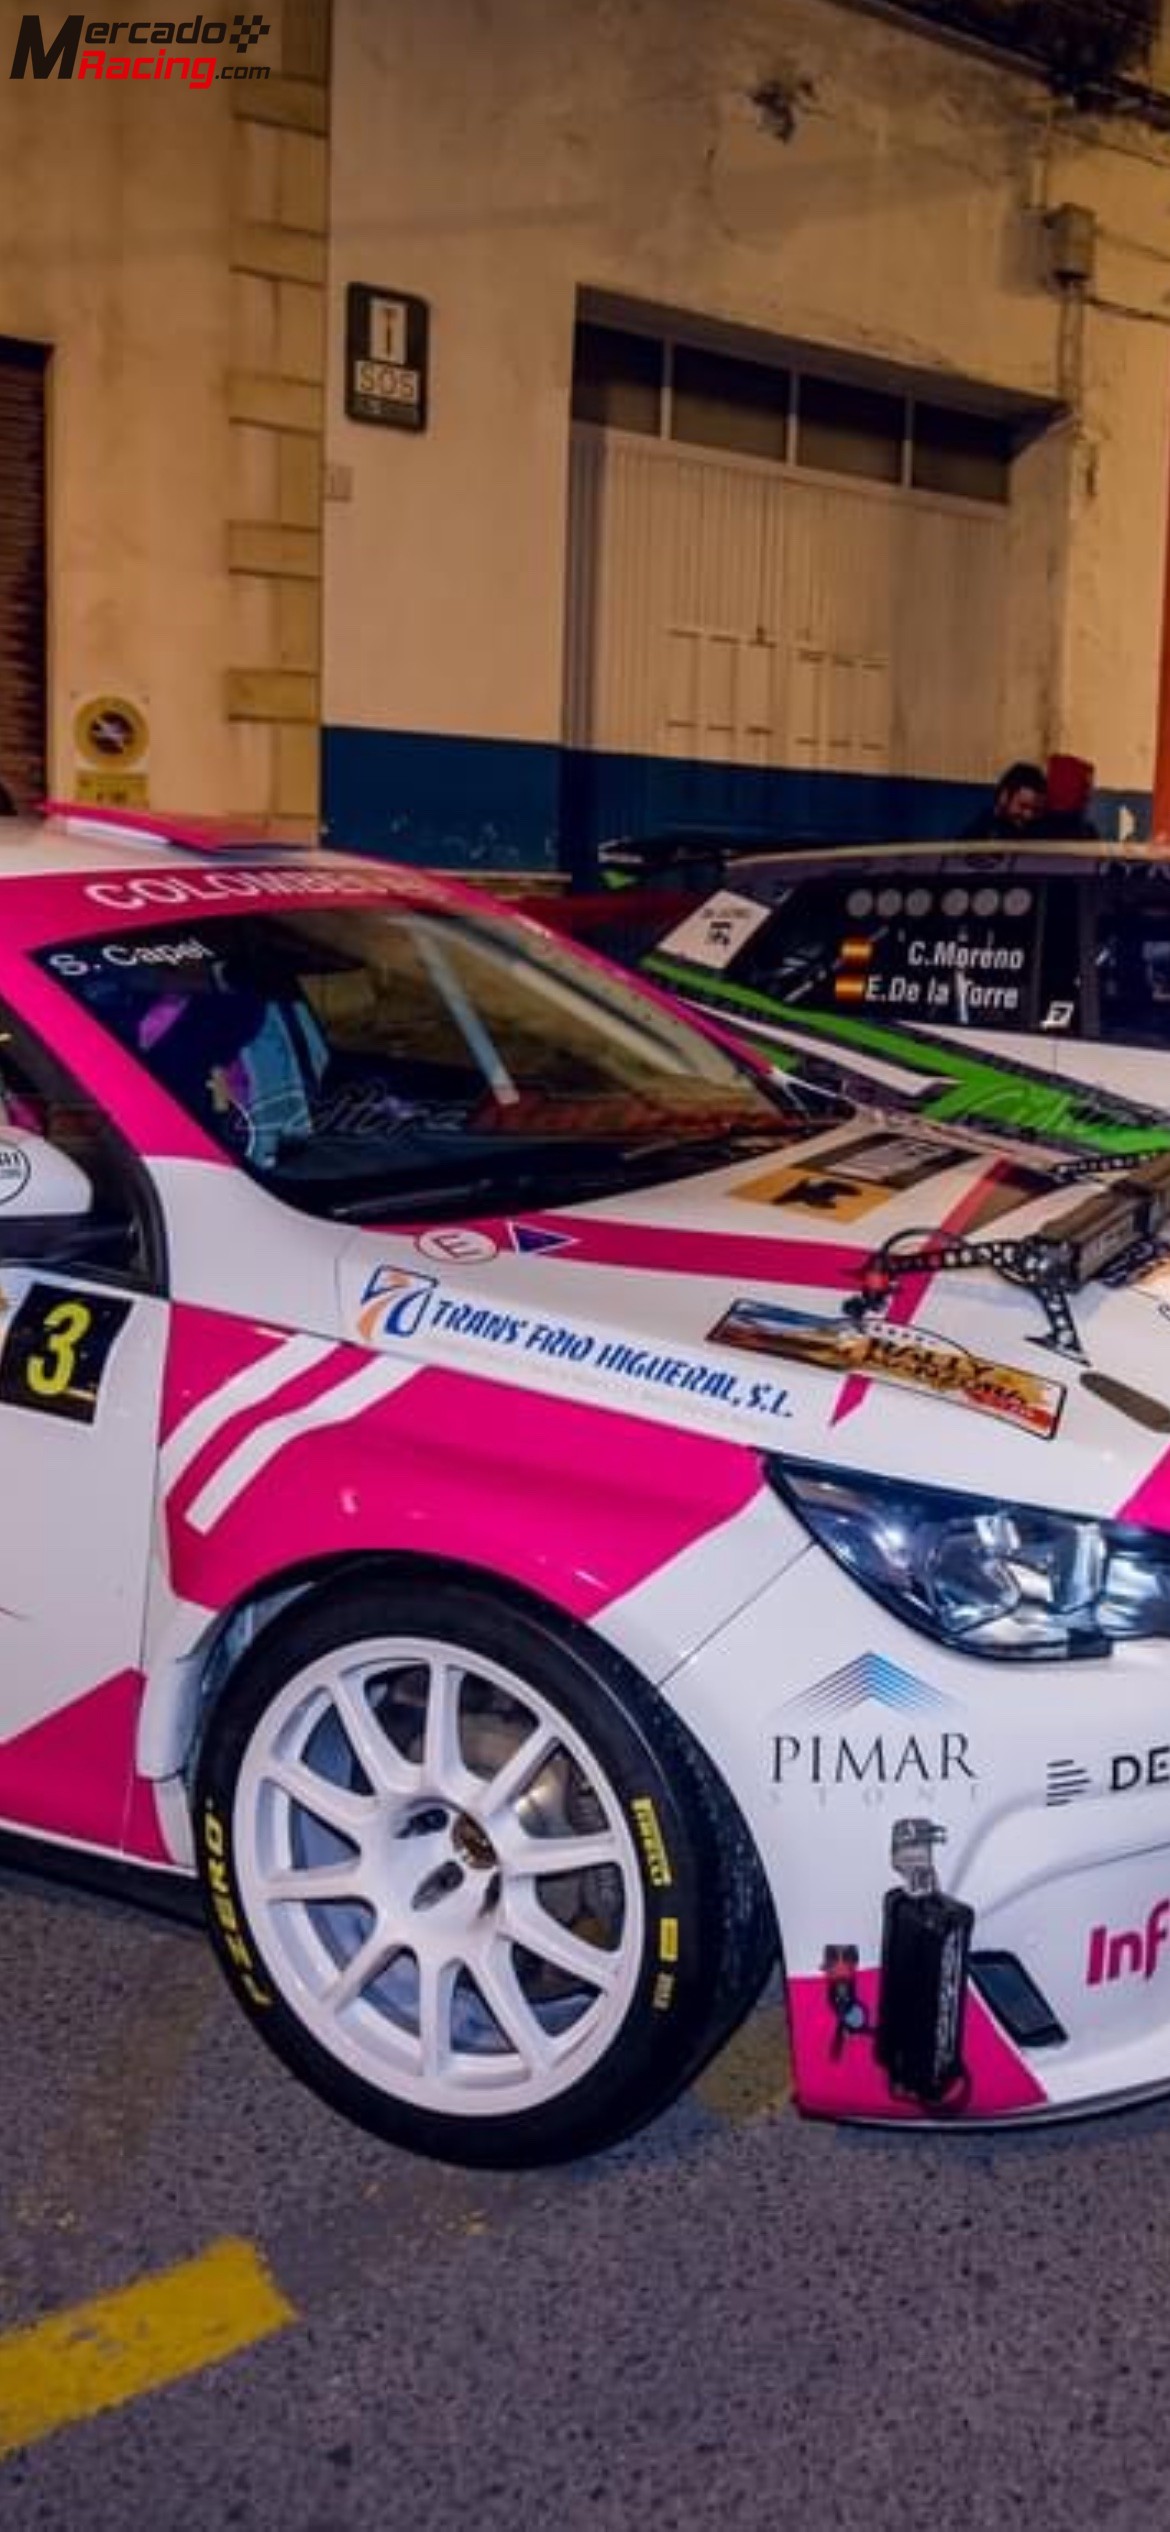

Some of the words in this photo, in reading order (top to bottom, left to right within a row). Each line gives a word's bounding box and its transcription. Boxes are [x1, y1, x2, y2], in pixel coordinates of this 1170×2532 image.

[359, 365, 416, 399] SOS
[49, 954, 102, 977] S.
[907, 940, 1025, 971] C.Moreno
[926, 977, 950, 1005] la
[431, 1299, 528, 1344] TRANS
[525, 1323, 595, 1361] FRIO
[27, 1301, 91, 1395] 3
[771, 1731, 979, 1783] PIMAR
